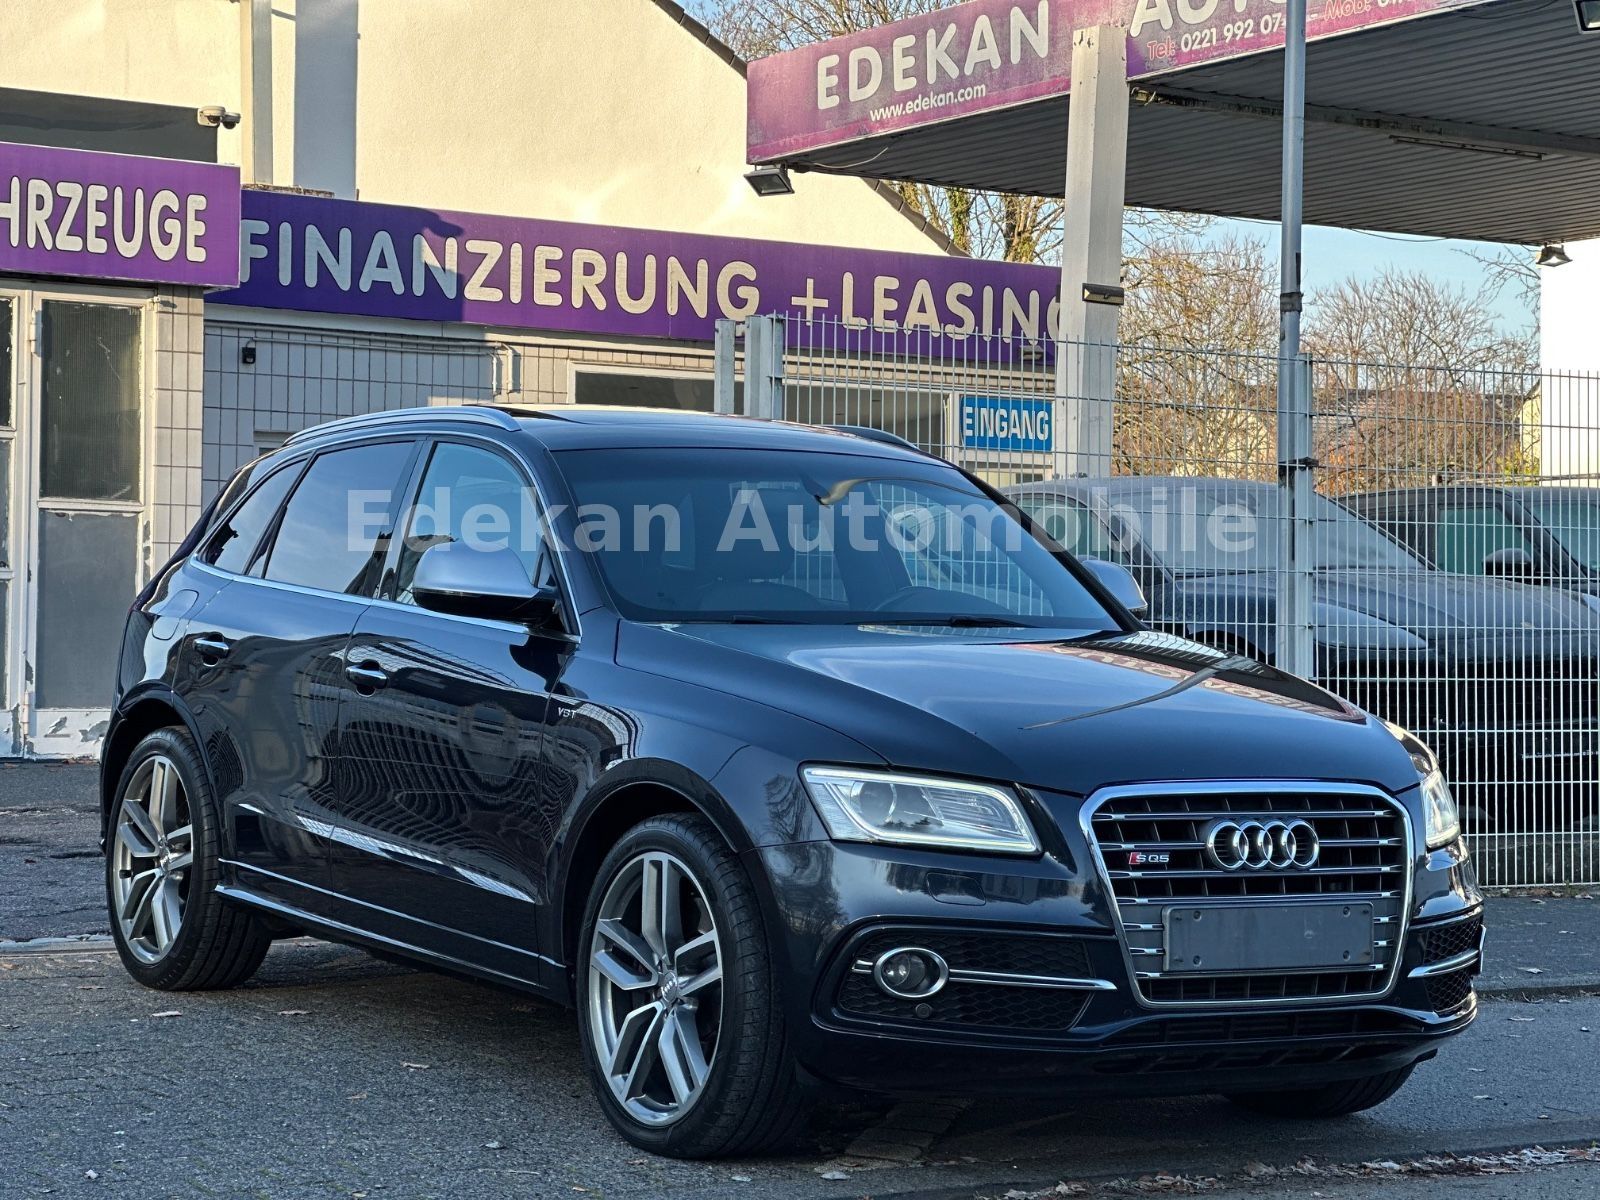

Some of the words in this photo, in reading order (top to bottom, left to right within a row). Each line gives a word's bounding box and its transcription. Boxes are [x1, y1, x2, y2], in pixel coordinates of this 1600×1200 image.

[816, 0, 1050, 110] EDEKAN
[1147, 36, 1176, 60] Tel:
[1181, 27, 1217, 52] 0221
[1223, 19, 1254, 43] 992
[869, 82, 986, 122] www.edekan.com
[241, 219, 760, 323] FINANZIERUNG
[963, 405, 1050, 441] EINGANG
